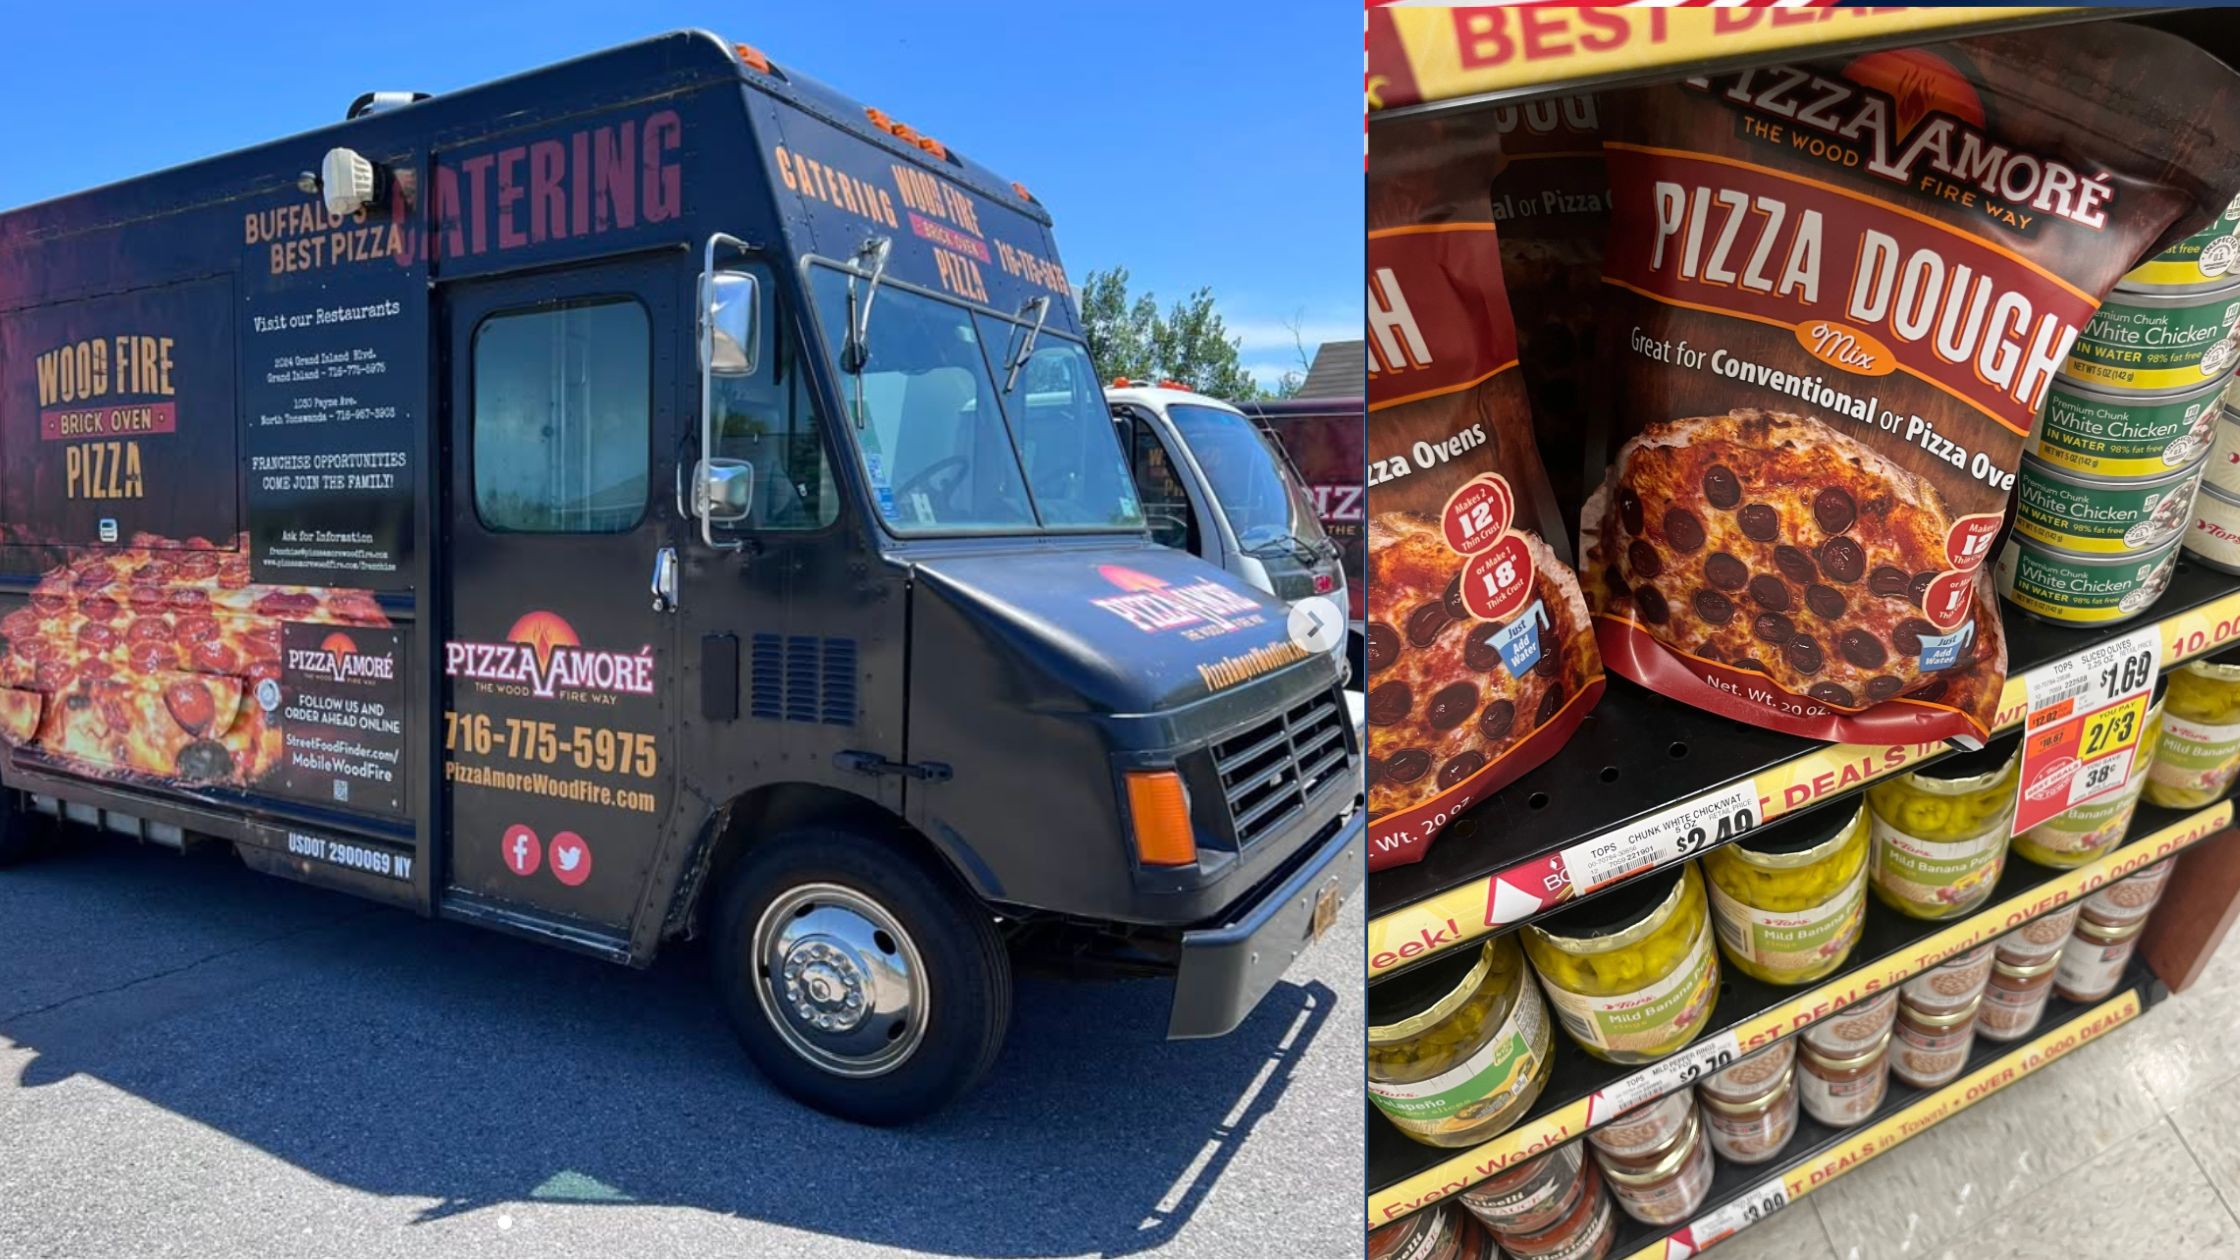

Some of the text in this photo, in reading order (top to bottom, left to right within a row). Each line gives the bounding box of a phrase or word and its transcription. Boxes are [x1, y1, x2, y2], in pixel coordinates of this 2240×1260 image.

[1451, 6, 1668, 71] BEST
[391, 109, 681, 268] CATERING
[775, 146, 898, 229] CATERING
[1744, 115, 2033, 231] THE WOOD FIRE WAY
[1888, 115, 2112, 231] AMORÉ
[891, 164, 984, 239] WOOD FIRE
[1544, 190, 1602, 215] Pizza
[245, 200, 367, 244] BUFFALOS
[270, 223, 402, 274] BEST PIZZA
[933, 247, 989, 304] PIZZA
[1649, 181, 2079, 413] PIZZA DOUGH
[254, 299, 400, 332] Visit our Restaurants
[2133, 314, 2169, 326] Chunk
[1811, 323, 1874, 371] Mix
[2084, 322, 2218, 345] White Chicken
[295, 354, 319, 366] Grand
[321, 351, 350, 364] Island
[2077, 341, 2183, 363] IN WATER 98% fat
[37, 336, 175, 406] WOOD FIRE
[267, 371, 291, 383] Grand
[292, 369, 320, 381] Island
[1631, 326, 1671, 363] Great
[1676, 340, 1707, 370] for
[1710, 348, 1878, 425] Conventional
[1880, 407, 1904, 433] or
[1905, 415, 1966, 469] Pizza
[2053, 396, 2129, 421] Premium Chunk
[60, 408, 152, 434] BRICK OVEN
[260, 412, 327, 426] North Tonawanda
[2051, 407, 2178, 439] White Chicken
[1413, 423, 1487, 469] Ovens
[2063, 435, 2105, 451] WATER
[66, 441, 143, 498] PIZZA
[252, 452, 407, 470] FRANCHISE OPPORTUNITIES
[263, 474, 394, 490] COME JOIN THE FAMILY!
[1455, 488, 1487, 515] Makes 2
[1458, 496, 1494, 539] 12"
[2021, 487, 2138, 520] White Chicken
[282, 530, 373, 543] Ask for Information
[1461, 522, 1500, 552] Thin Crust
[2208, 524, 2240, 545] Tops
[1482, 555, 1517, 598] 18"
[1485, 552, 1505, 571] Make
[2022, 563, 2132, 593] White Chicken
[1486, 579, 1524, 611] Thick Crust
[1508, 620, 1526, 639] Just
[1513, 635, 1530, 653] Add
[1938, 635, 1957, 647] Just
[2138, 640, 2153, 650] PRICE
[288, 649, 393, 682] PIZZA AMORÉ
[445, 641, 654, 697] PIZZA AMORÉ
[1511, 642, 1537, 667] Water
[2053, 639, 2132, 674] TOPS SLICED OLIVES
[2104, 655, 2114, 663] OZ
[2100, 650, 2152, 699] $1.69
[299, 694, 385, 717] FOLLOW US AND
[475, 682, 617, 705] THE WOOD FIRE WAY
[1707, 674, 1832, 716] Net. Wt. 20 oz.
[285, 706, 400, 734] ORDER AHEAD ONLINE
[2085, 710, 2136, 755] 2/$3
[286, 733, 399, 764] StreetFoodFinder.com/
[444, 711, 657, 778] 716-775-5975
[2164, 738, 2190, 754] Mild
[292, 752, 393, 783] MobileWoodFire
[1783, 744, 1907, 812] DEALS
[445, 761, 655, 812] PizzaAmoreWoodFire.com
[1732, 799, 1752, 811] PRICE
[2068, 807, 2114, 819] Banana
[1375, 796, 1473, 854] Wt. 20 oz.
[1591, 794, 1741, 858] TOPS CHUNK WHITE CHICK/WAT
[1676, 808, 1754, 853] $249
[1684, 820, 1697, 831] OZ
[289, 832, 412, 879] USDOT 2900069 NY
[1889, 851, 1967, 873] Mild Banana
[1764, 914, 1845, 941] Mild Banana
[1792, 816, 2225, 1029] DEALS in Town! OVER DEALS
[1371, 918, 1463, 968] eek!
[1609, 981, 1693, 1023] Mild Banana
[1626, 1052, 1695, 1088] TOPS MILD PEPPER
[1377, 1097, 1446, 1110] Jalapeño
[1810, 1003, 2136, 1185] DEALS in Town! OVER DEALS
[1383, 1177, 1470, 1220] Every
[1475, 1125, 1568, 1176] Week!
